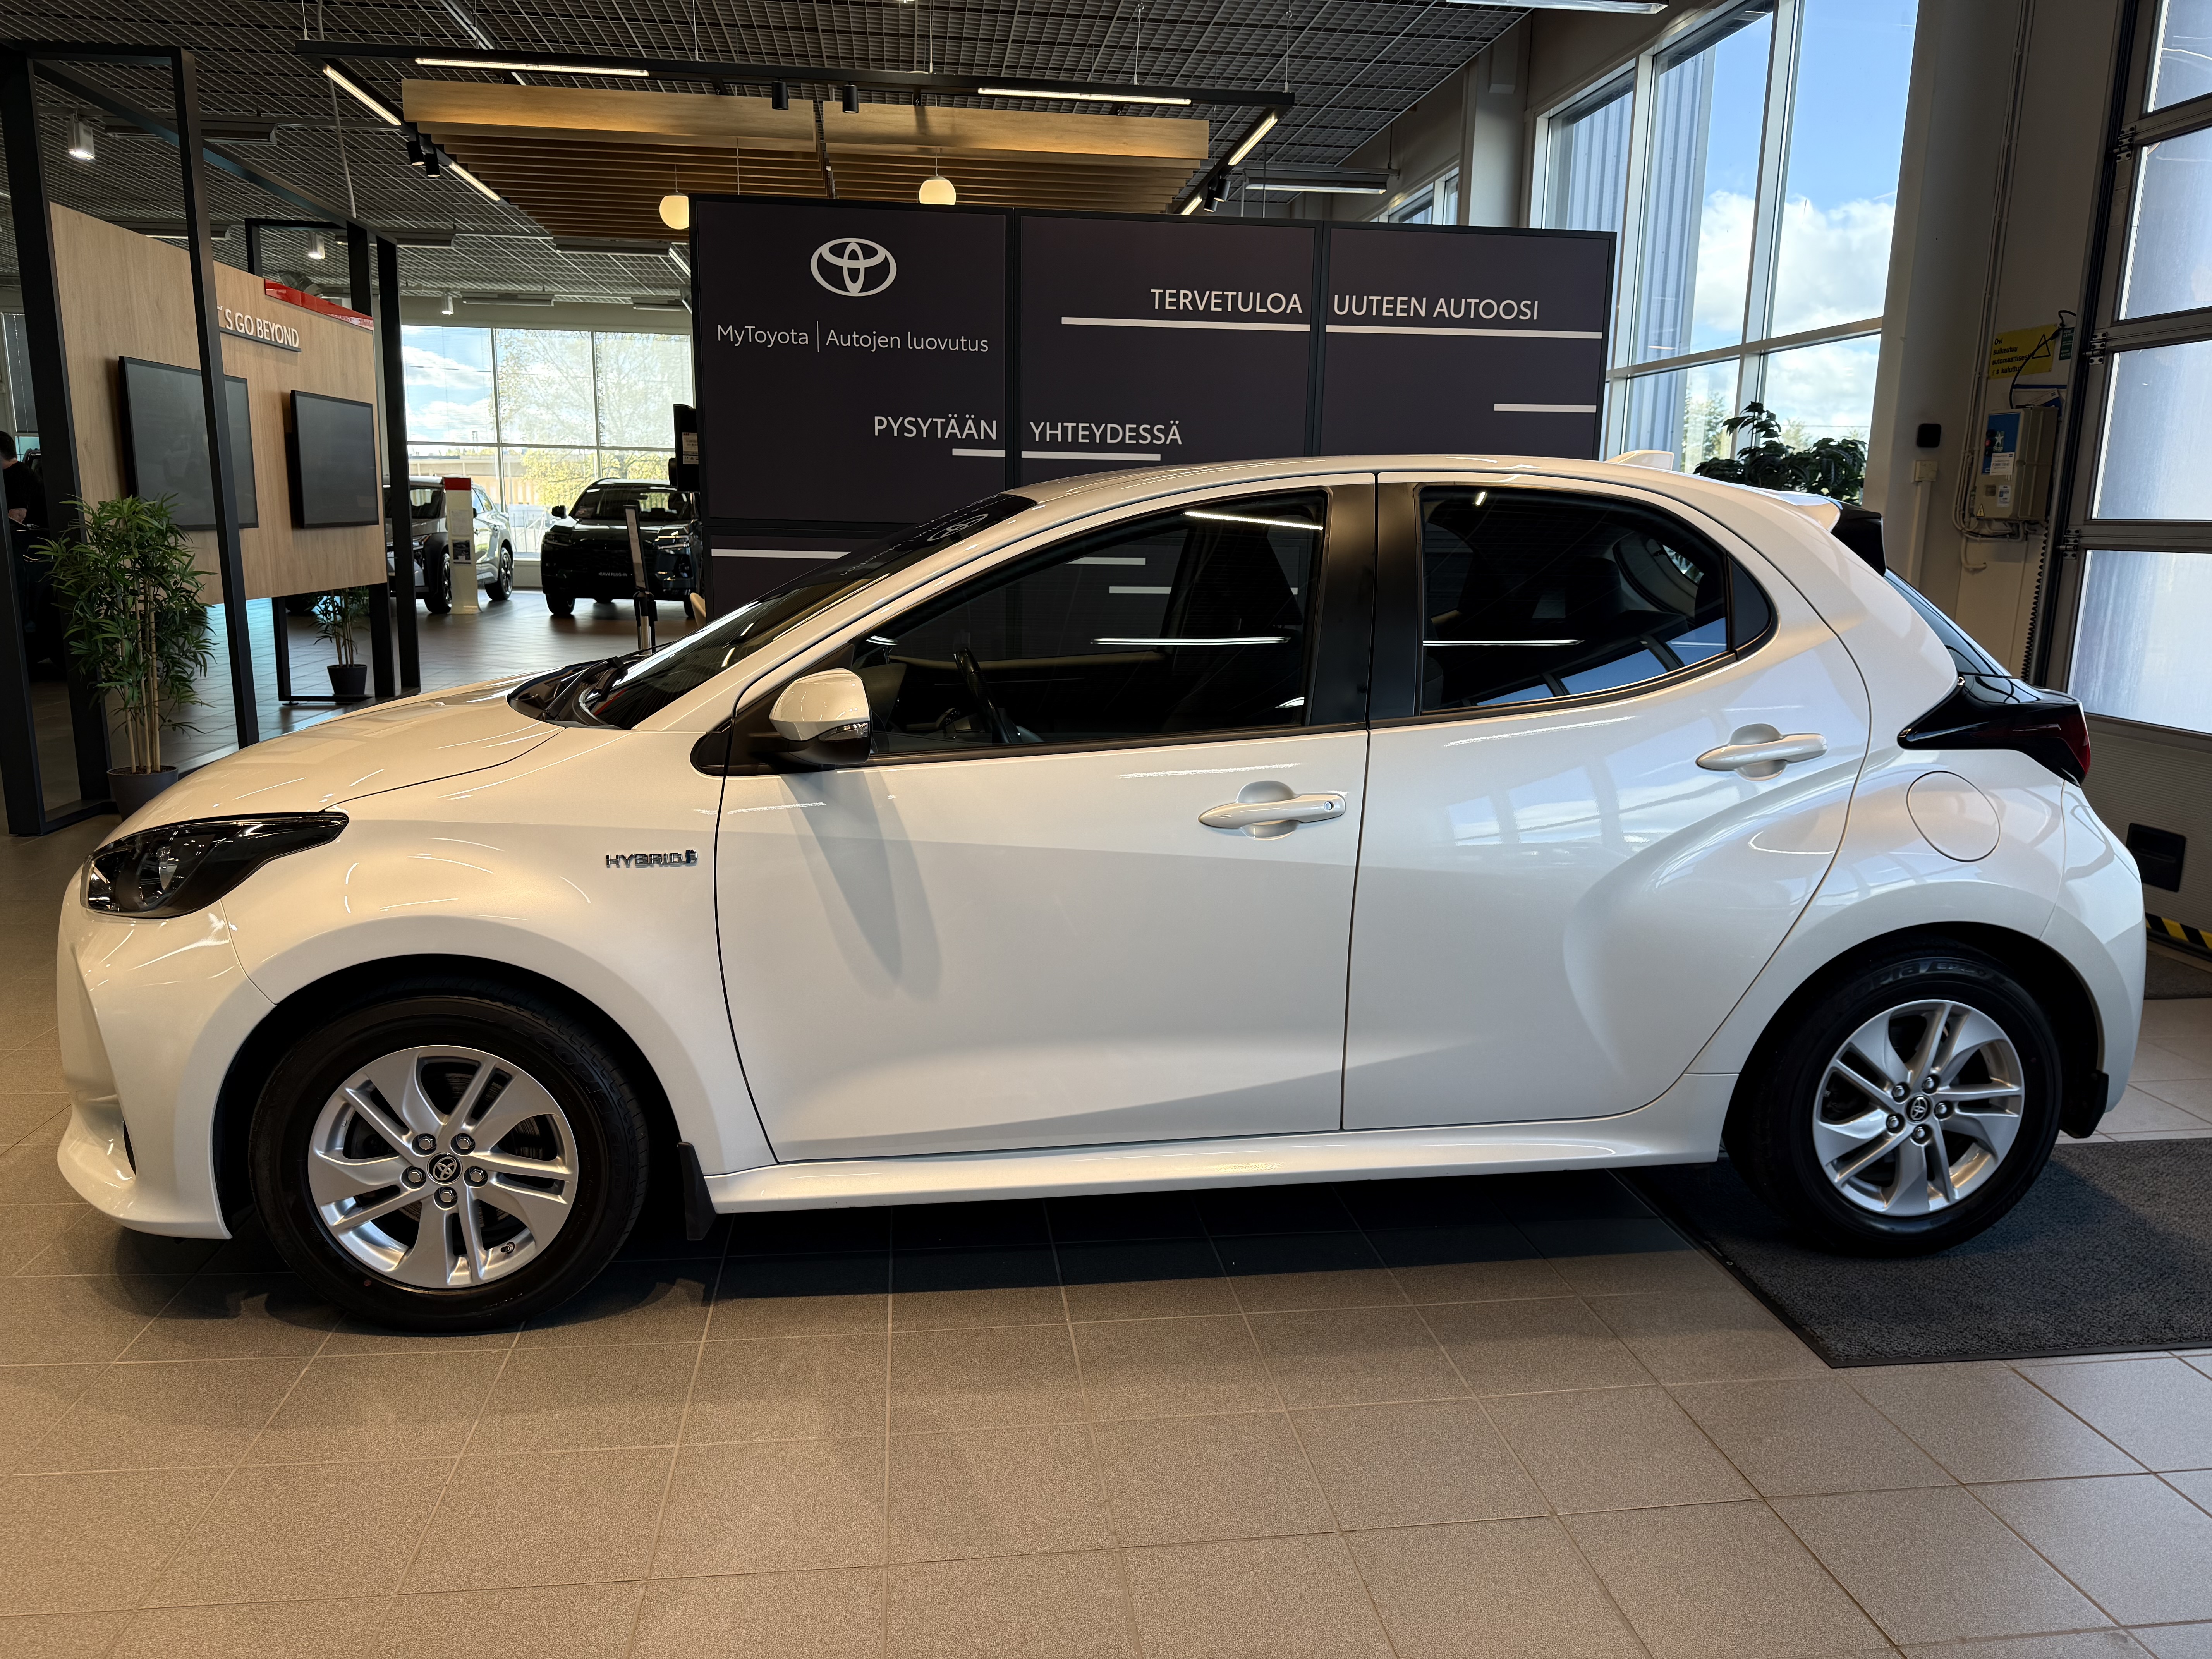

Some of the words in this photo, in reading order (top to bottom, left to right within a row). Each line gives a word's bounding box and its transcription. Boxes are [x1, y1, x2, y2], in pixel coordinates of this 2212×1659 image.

[1151, 289, 1303, 314] TERVETULOA
[1334, 295, 1426, 317] UUTEEN
[1433, 298, 1538, 320] AUTOOSI
[235, 312, 254, 335] GO
[256, 318, 299, 347] BEYOND
[718, 325, 808, 348] MyToyota
[826, 329, 900, 352] Autojen
[908, 331, 988, 352] luovutus
[1992, 353, 2031, 365] automaattisest
[1993, 347, 2018, 355] sulkeutuu
[2001, 366, 2020, 374] kuluttu
[874, 414, 996, 440] PYSYTÄÄN
[1030, 420, 1182, 445] YHTEYDESSÄ
[606, 852, 682, 868] HYBRID
